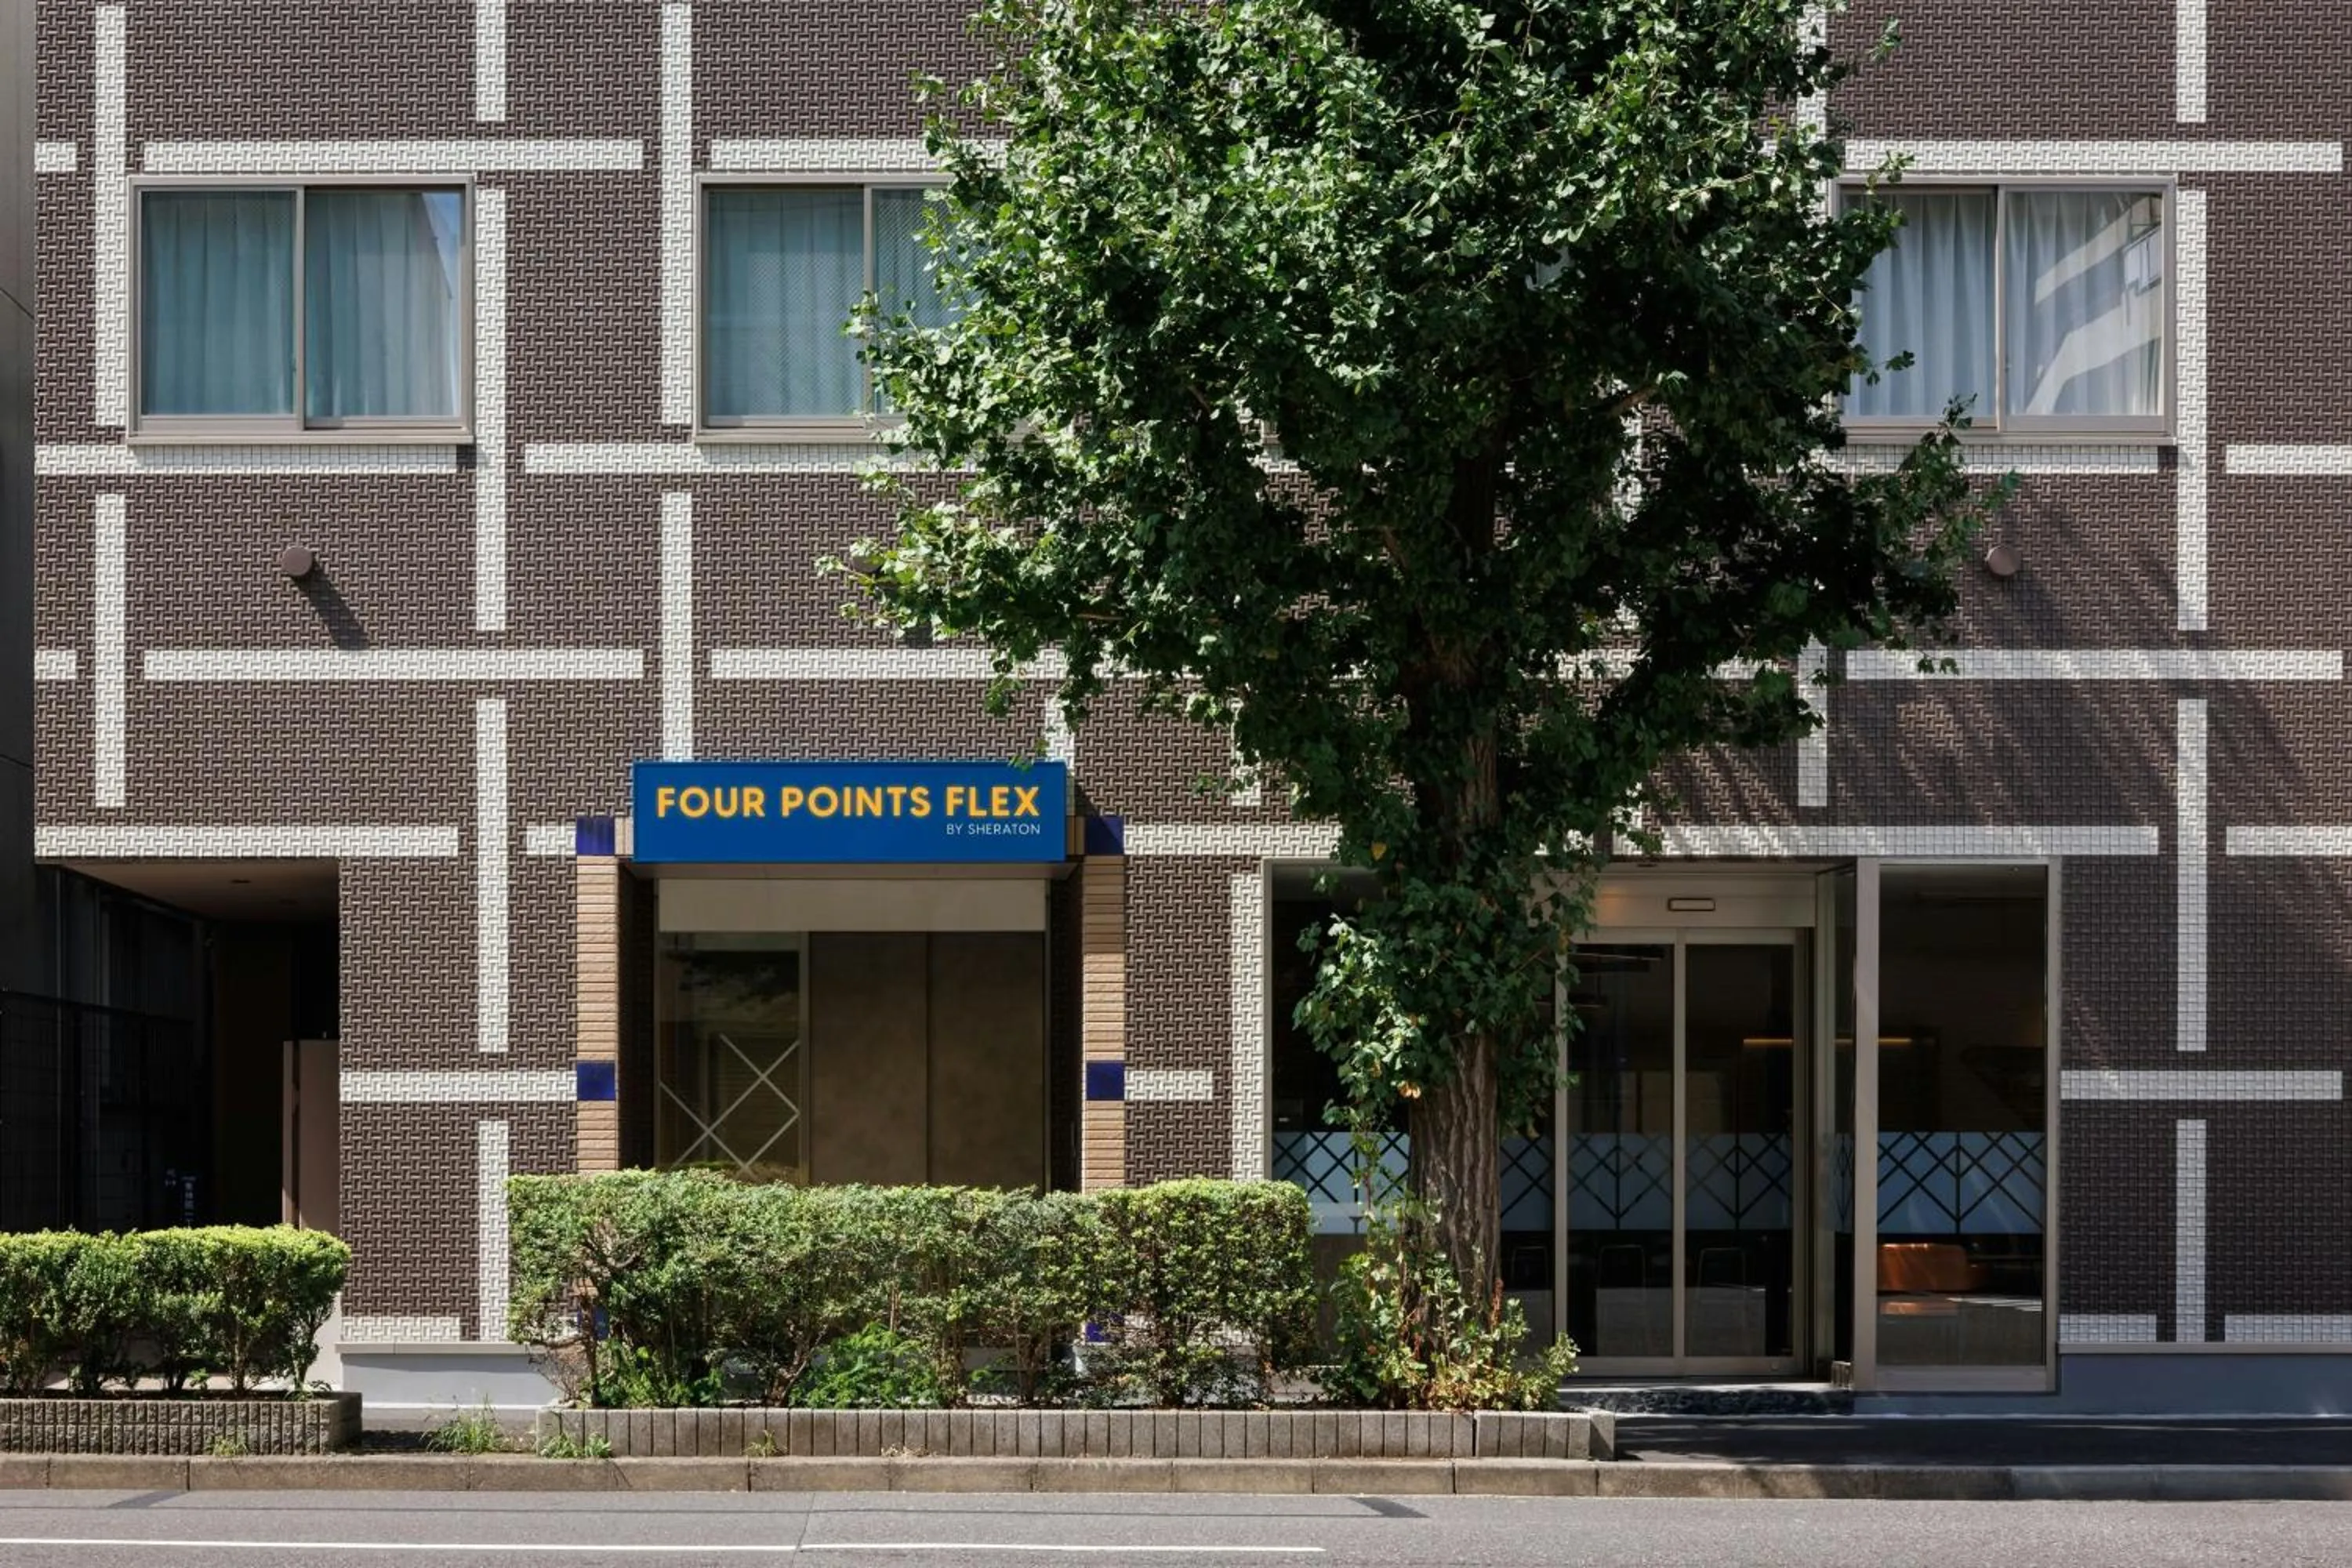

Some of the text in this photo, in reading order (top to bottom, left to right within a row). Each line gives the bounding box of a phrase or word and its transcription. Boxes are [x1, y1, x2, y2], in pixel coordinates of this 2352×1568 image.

[656, 786, 1040, 817] FOUR POINTS FLEX
[946, 823, 1040, 835] BY SHERATON
